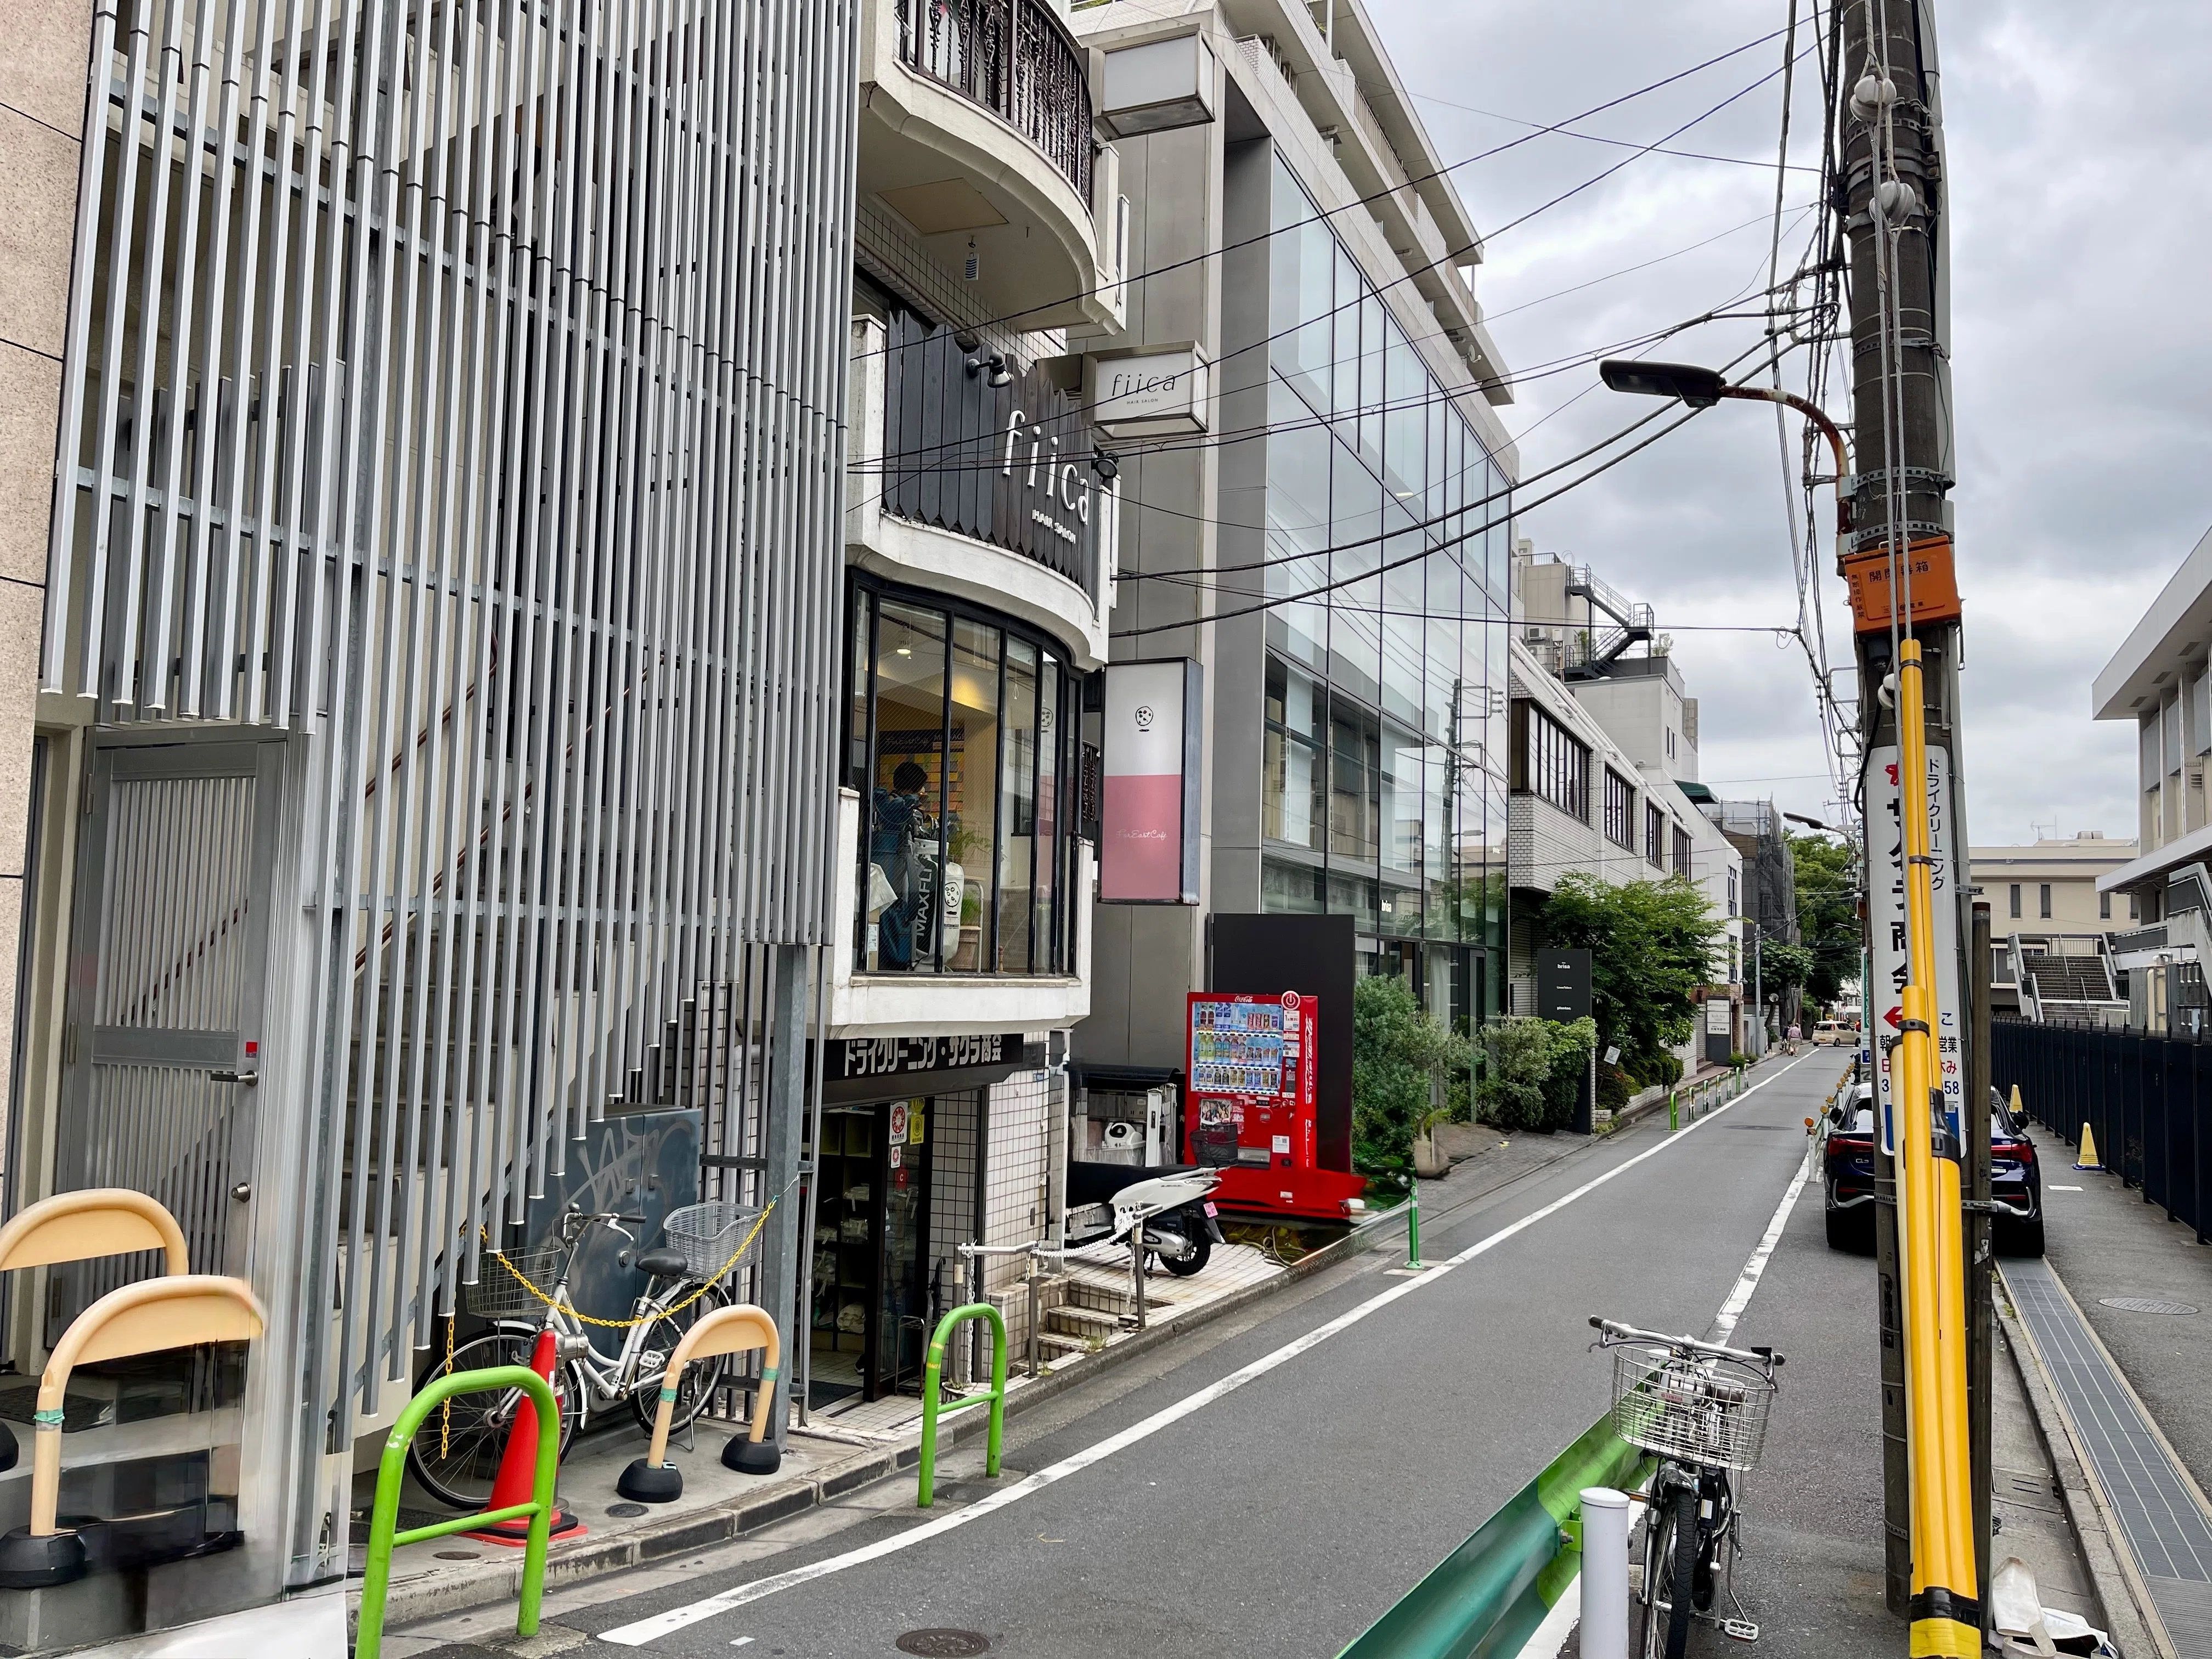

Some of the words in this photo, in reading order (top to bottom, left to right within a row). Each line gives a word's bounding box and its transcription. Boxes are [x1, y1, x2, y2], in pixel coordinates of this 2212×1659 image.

[1111, 373, 1176, 396] fiica
[1002, 410, 1089, 526] fiica
[1031, 509, 1053, 529] HAIR
[1054, 522, 1076, 544] SALON
[1927, 758, 1945, 891] ドライクリーニング
